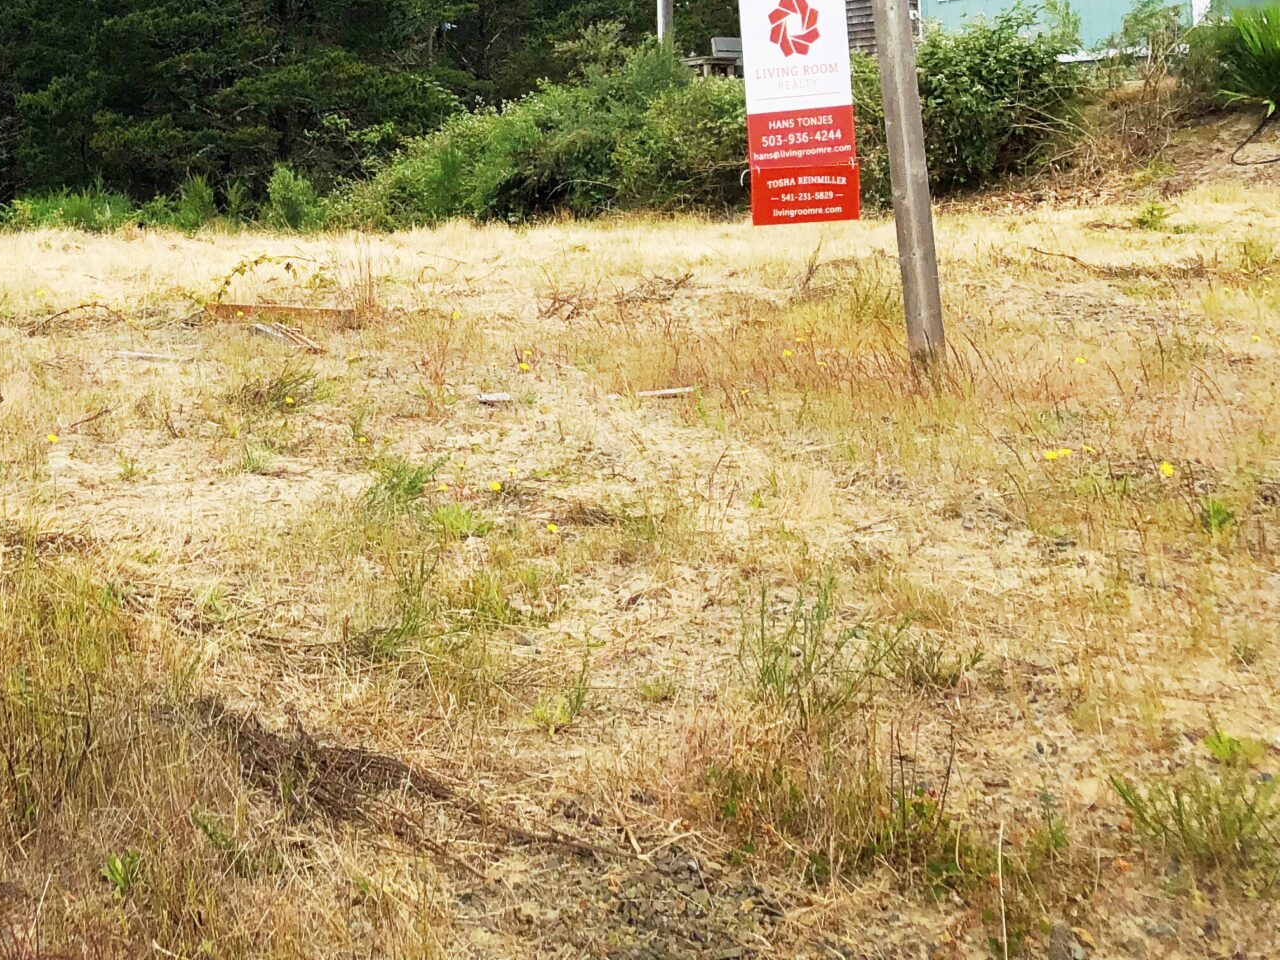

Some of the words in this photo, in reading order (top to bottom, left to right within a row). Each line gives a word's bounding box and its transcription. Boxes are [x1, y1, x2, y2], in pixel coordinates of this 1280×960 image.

[755, 66, 799, 80] LIVING
[803, 63, 839, 75] ROOM
[778, 79, 817, 90] REALTY
[768, 118, 795, 130] HANS
[797, 115, 833, 127] TONJES
[761, 128, 842, 147] 503-936-4244
[753, 144, 852, 161] hans@livingroomre.com
[766, 177, 796, 189] TOSHA
[797, 176, 847, 185] REINMILLER
[773, 206, 842, 218] livingroomre.com
